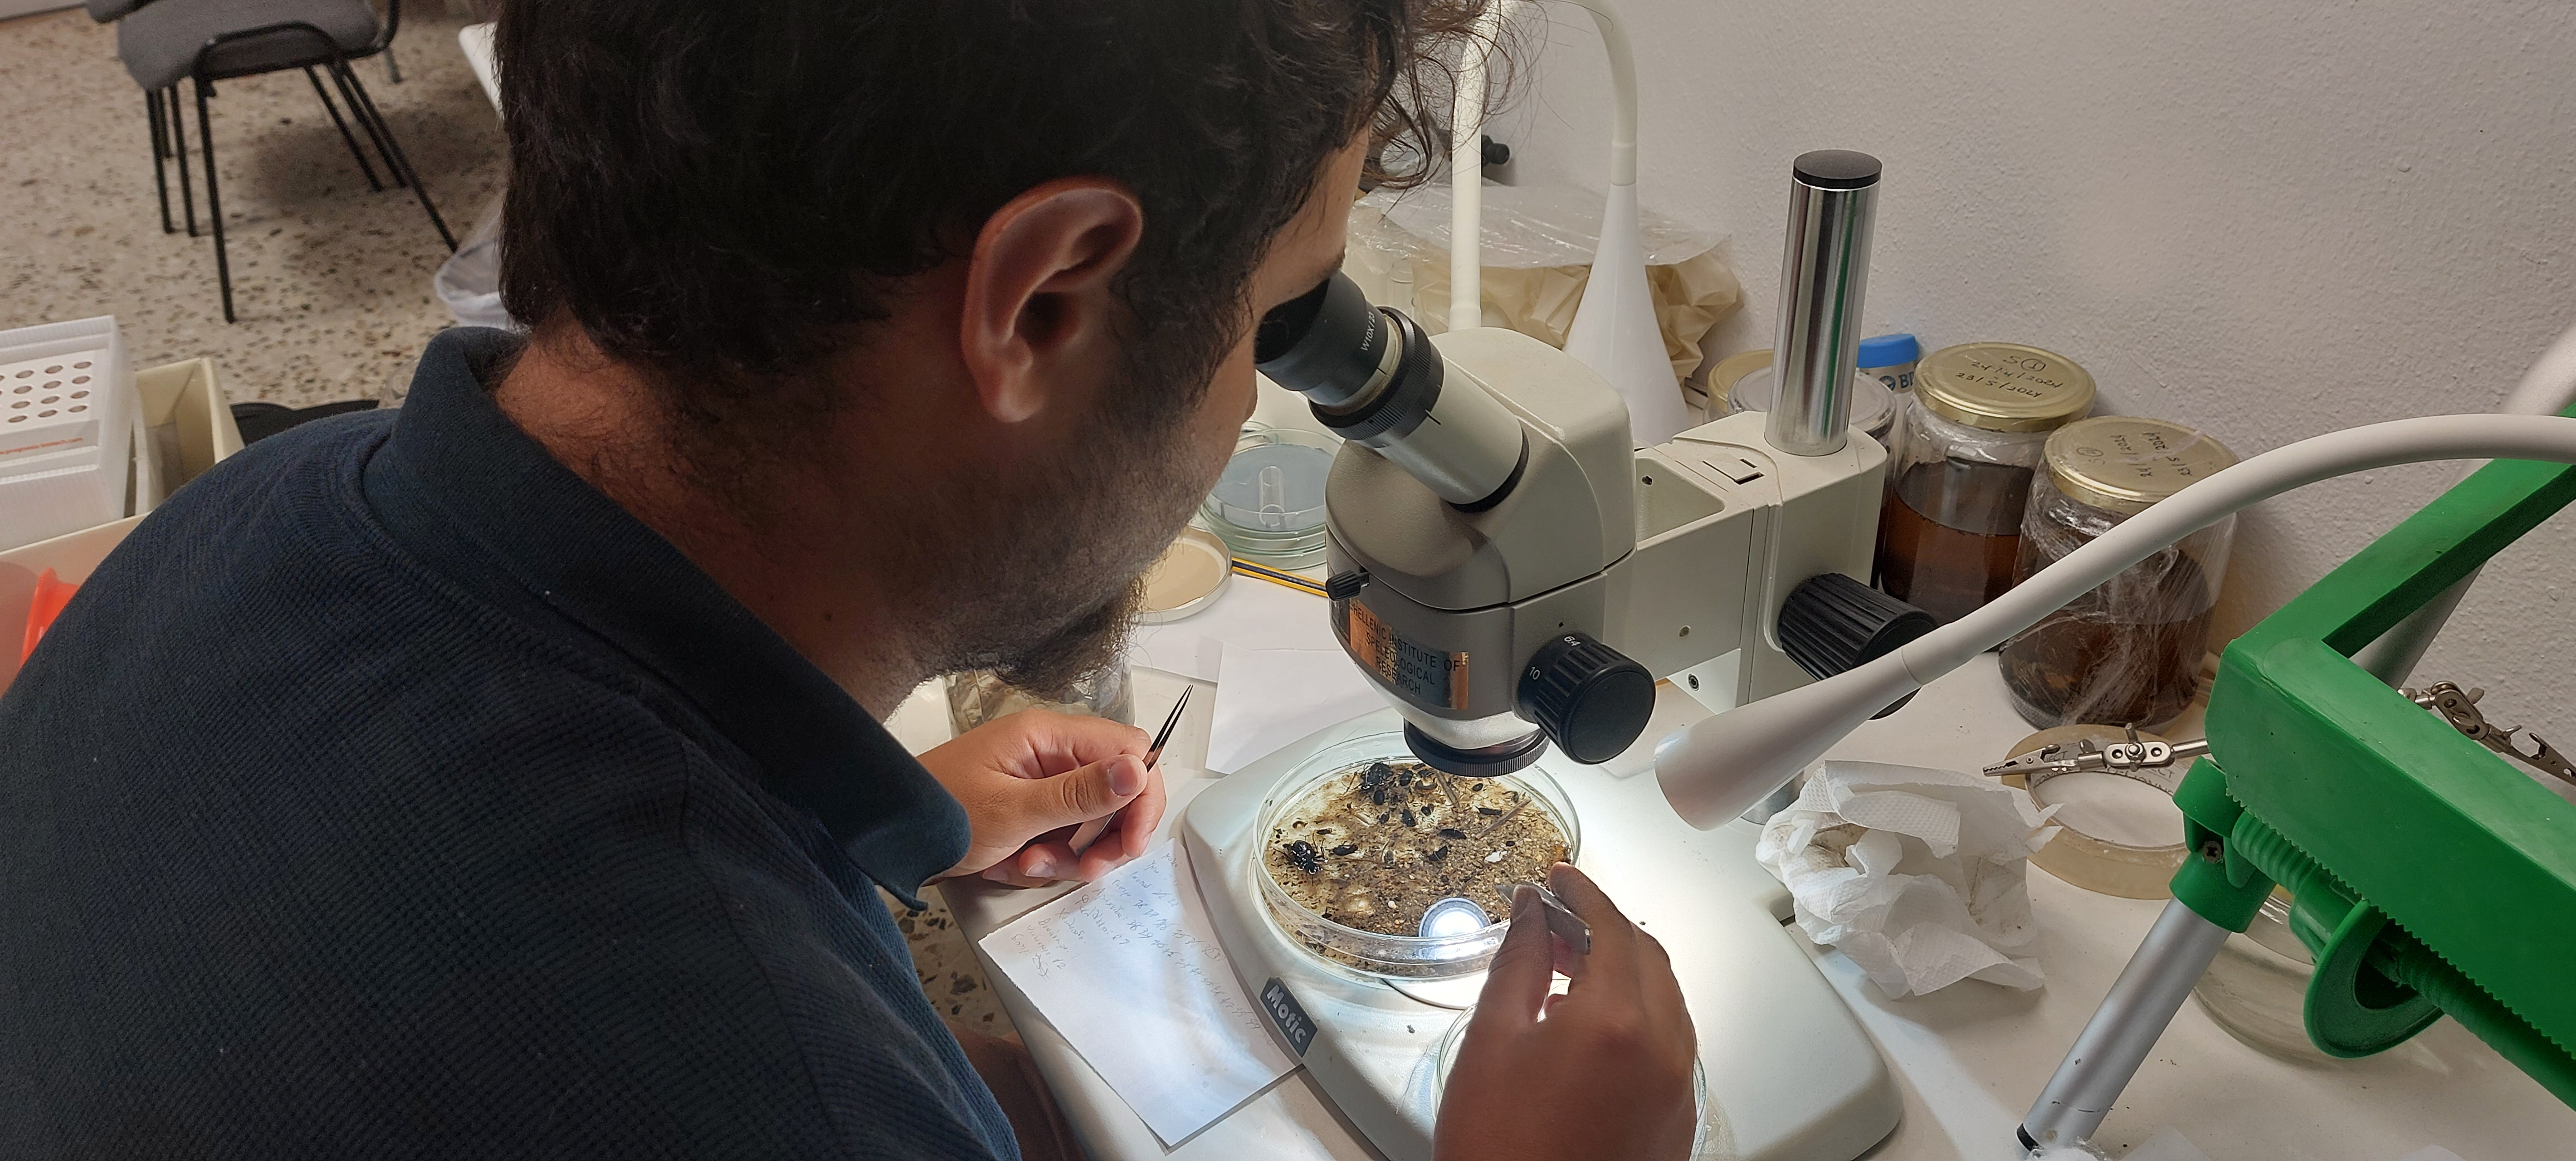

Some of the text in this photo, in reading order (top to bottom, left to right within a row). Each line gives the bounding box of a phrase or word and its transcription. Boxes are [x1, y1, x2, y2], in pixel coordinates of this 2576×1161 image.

[1353, 604, 1461, 672] HELLENIC INSTITUTE OF
[1366, 632, 1436, 685] SPELEOLOGICAL
[1376, 656, 1421, 695] RESEARCH
[1529, 666, 1541, 680] 10
[1266, 984, 1307, 1044] Motic
